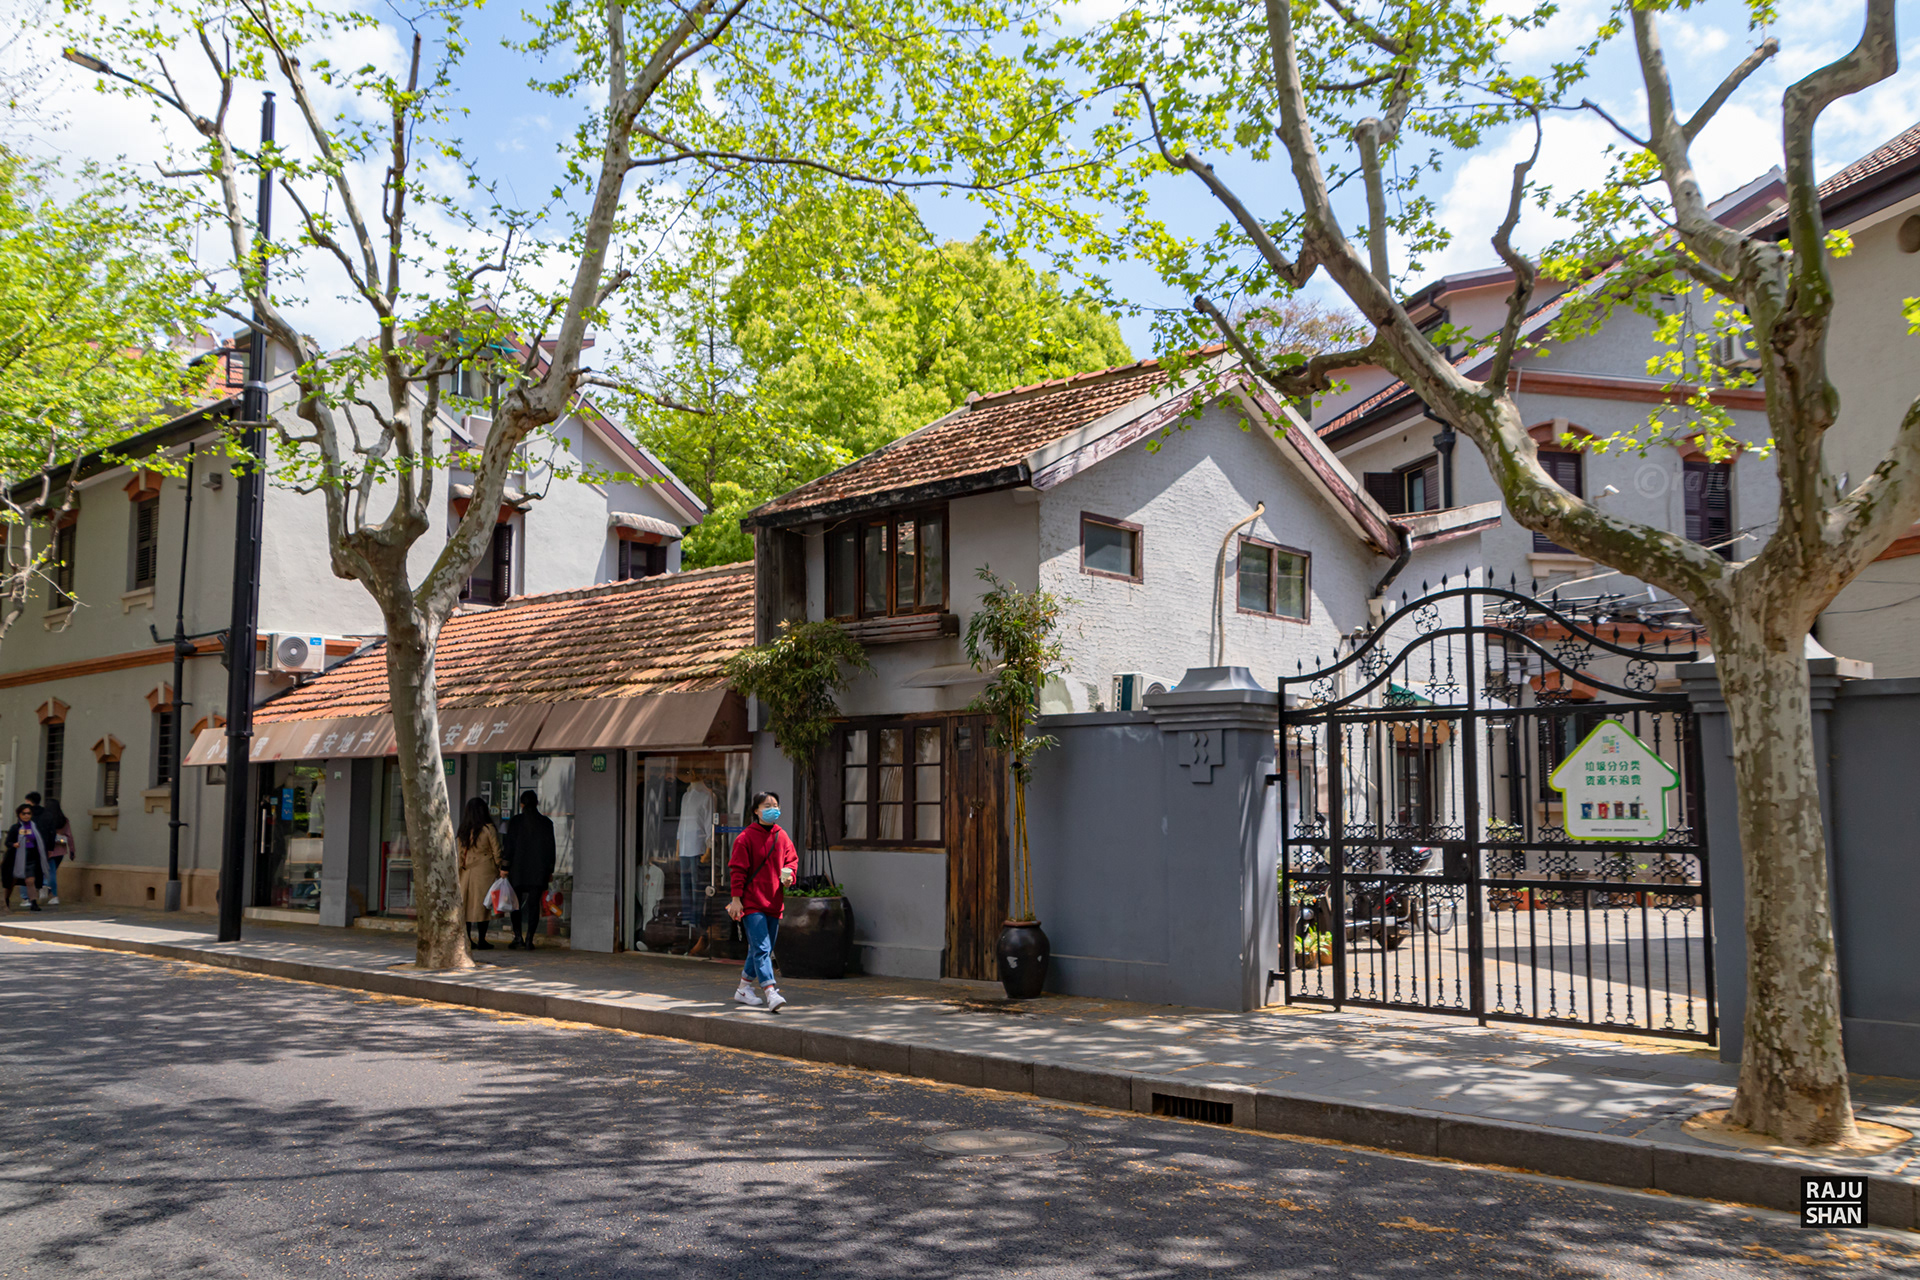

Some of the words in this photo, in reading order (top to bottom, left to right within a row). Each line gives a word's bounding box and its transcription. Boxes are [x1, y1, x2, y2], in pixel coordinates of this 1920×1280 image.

[438, 721, 508, 746] 安地产
[1585, 760, 1641, 772] 垃圾分分类
[1585, 774, 1642, 786] 资源不浪费
